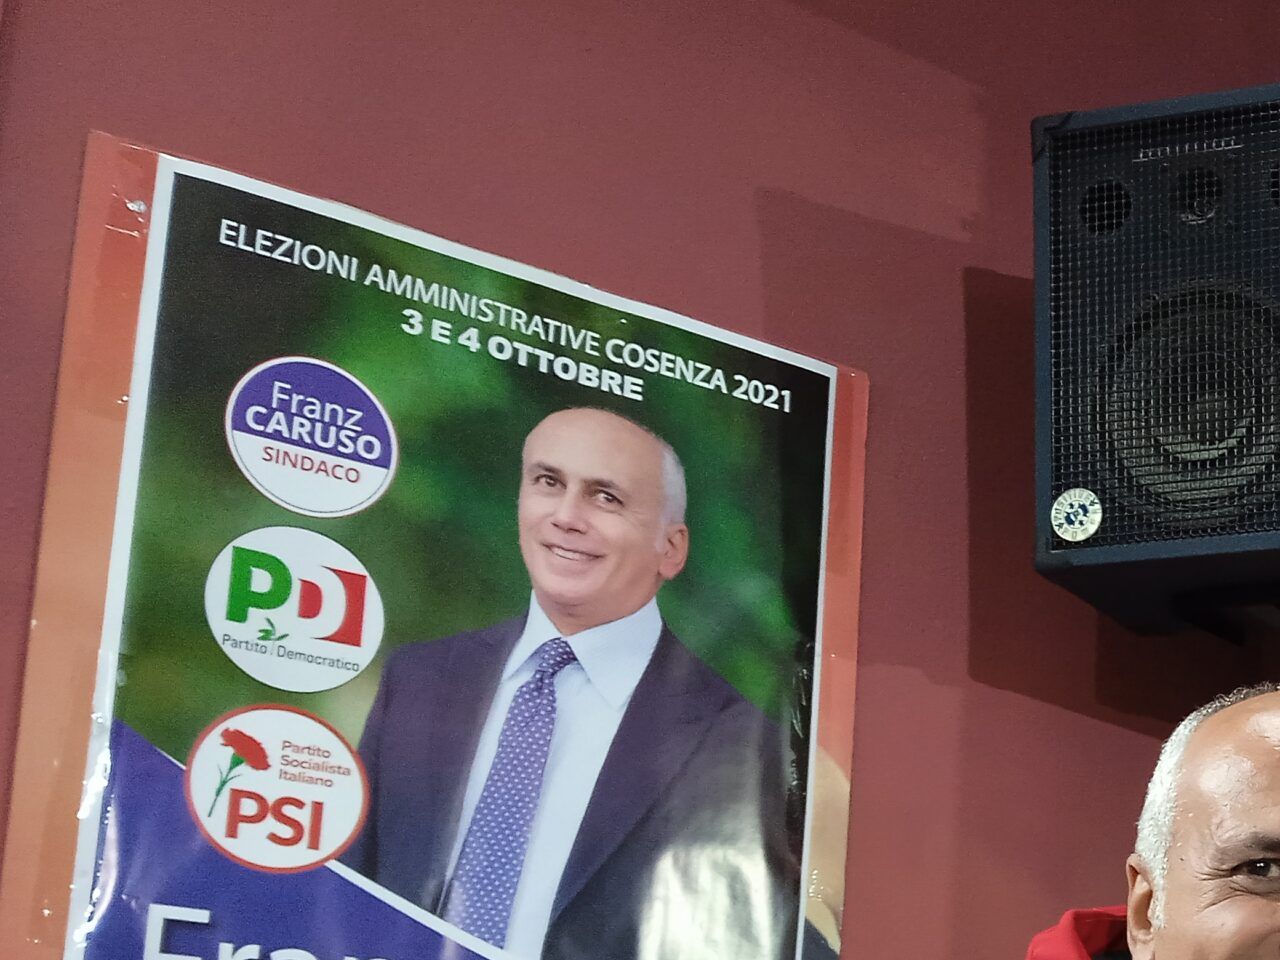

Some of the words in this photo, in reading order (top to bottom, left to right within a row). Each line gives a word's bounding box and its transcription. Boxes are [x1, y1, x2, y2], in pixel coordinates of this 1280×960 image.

[219, 219, 358, 281] ELEZIONI
[364, 263, 600, 355] AMMINISTRATIVE
[605, 337, 728, 395] COSENZA
[732, 375, 793, 414] 2021
[401, 309, 423, 336] 3
[431, 319, 450, 344] E
[457, 325, 480, 352] 4
[488, 336, 645, 401] OTTOBRE
[272, 381, 363, 432] Franz
[245, 405, 382, 460] CARUSO
[262, 446, 361, 484] SINDACO
[222, 634, 268, 655] Partito
[276, 645, 360, 673] Democratico
[281, 740, 331, 759] Partito
[281, 755, 352, 776] Socialista
[279, 769, 333, 788] Italiano
[225, 787, 324, 851] PSI
